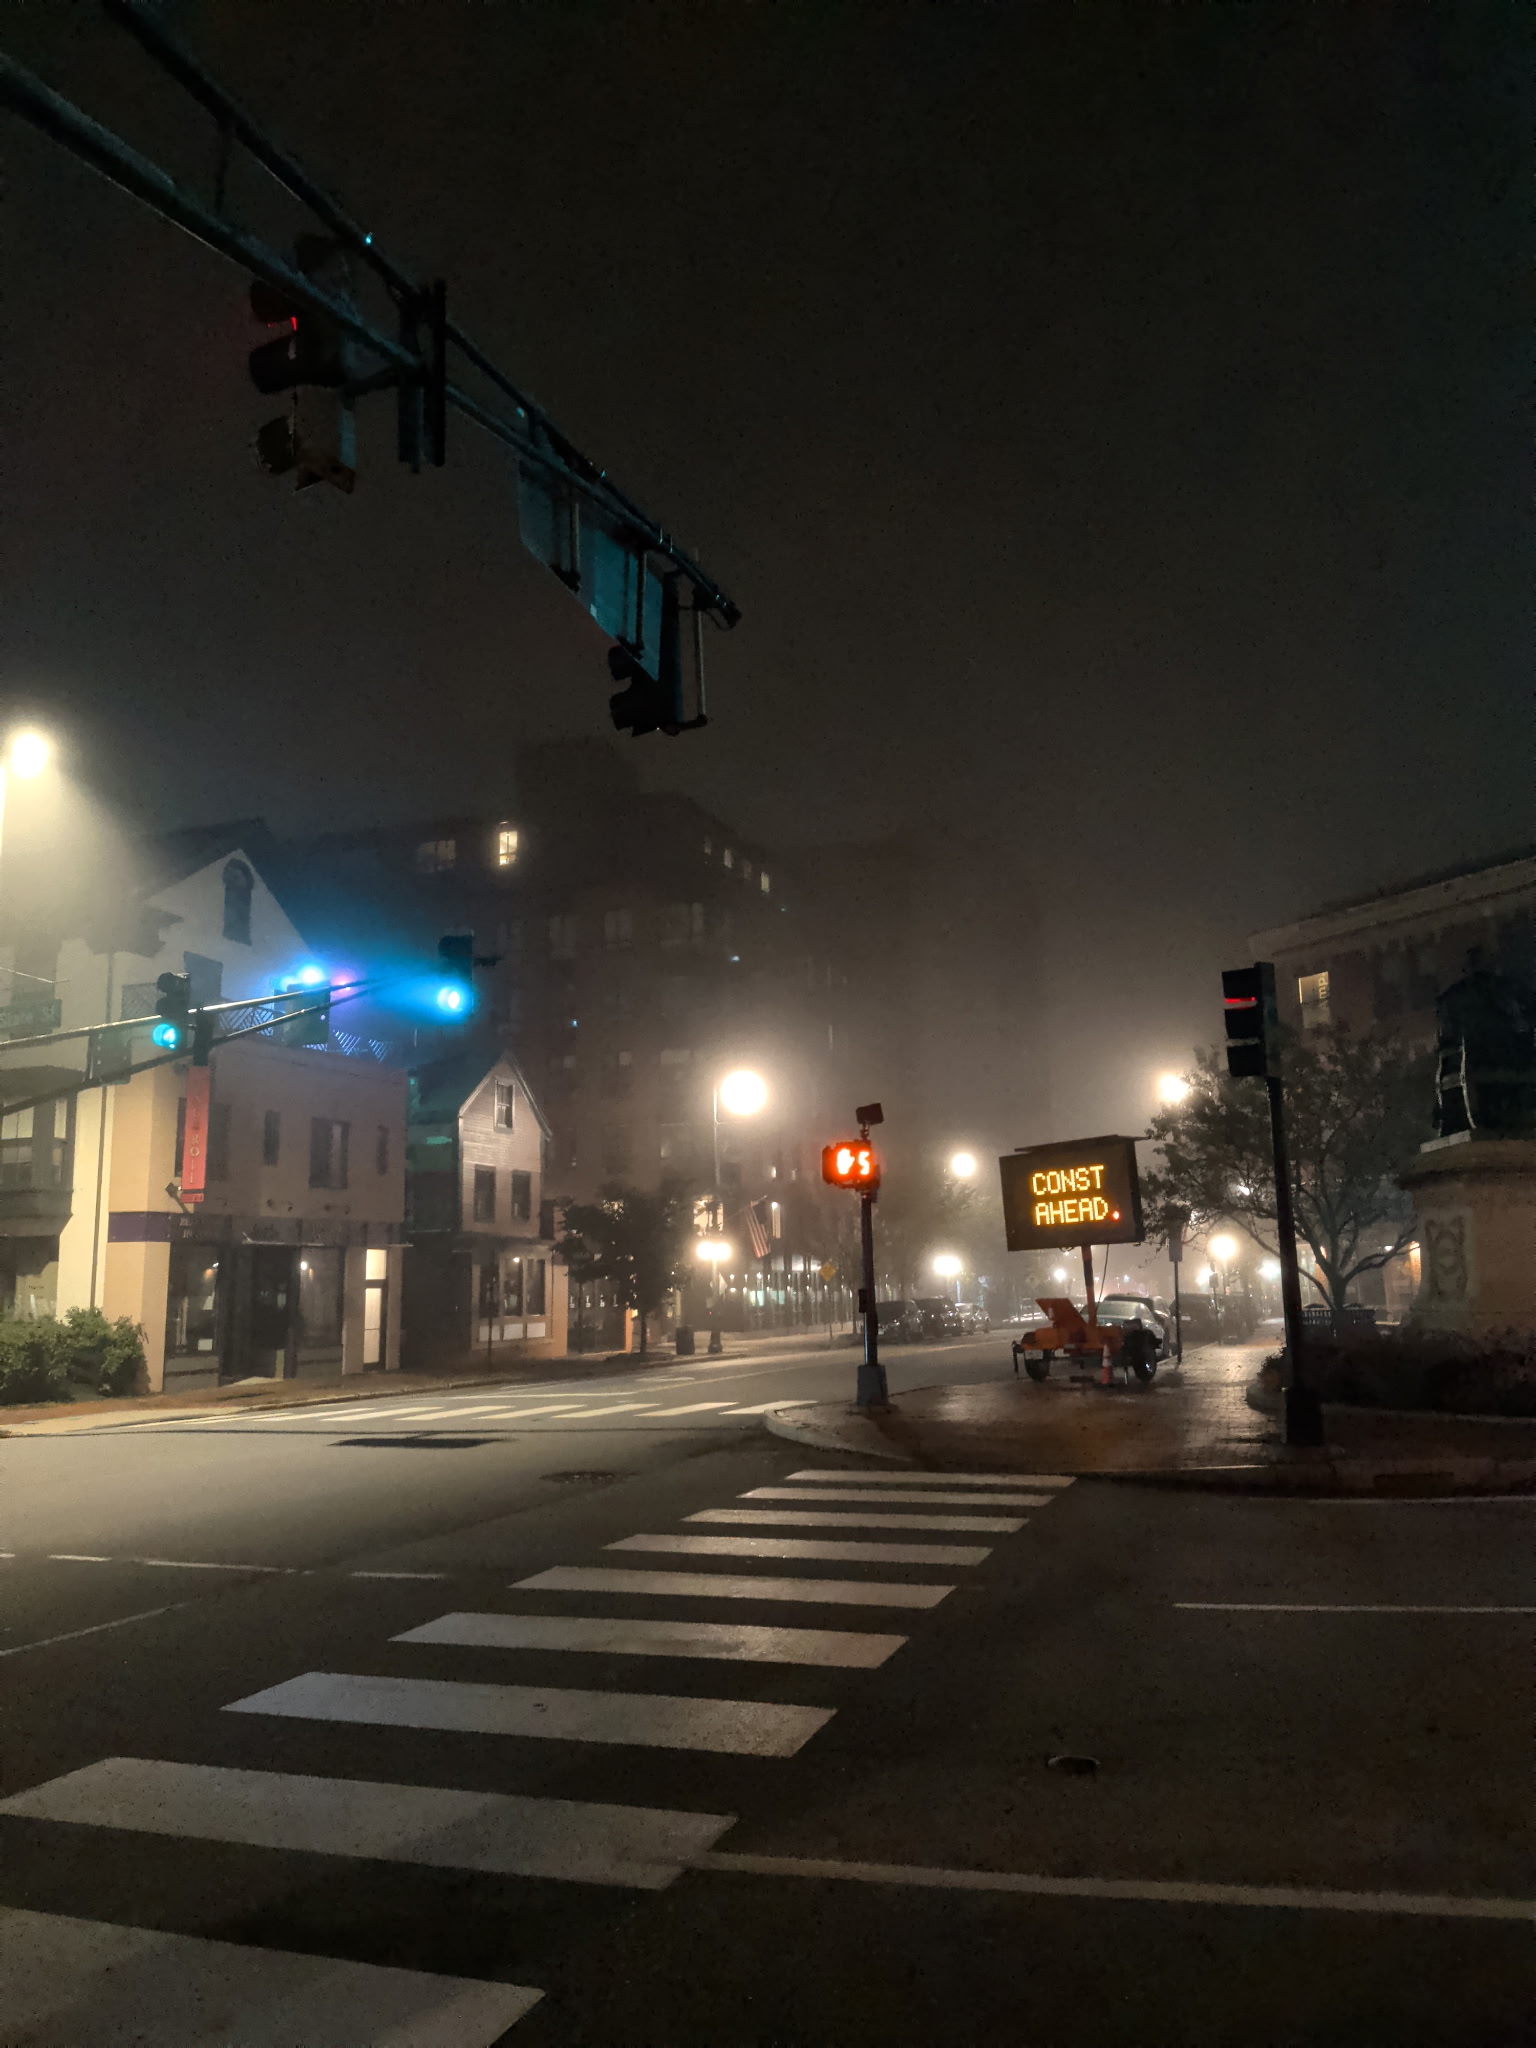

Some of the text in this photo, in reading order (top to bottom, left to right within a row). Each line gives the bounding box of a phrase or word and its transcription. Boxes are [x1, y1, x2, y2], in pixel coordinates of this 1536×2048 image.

[858, 1150, 870, 1175] 5
[1032, 1166, 1104, 1195] CONST
[1035, 1197, 1109, 1225] AHEAD
